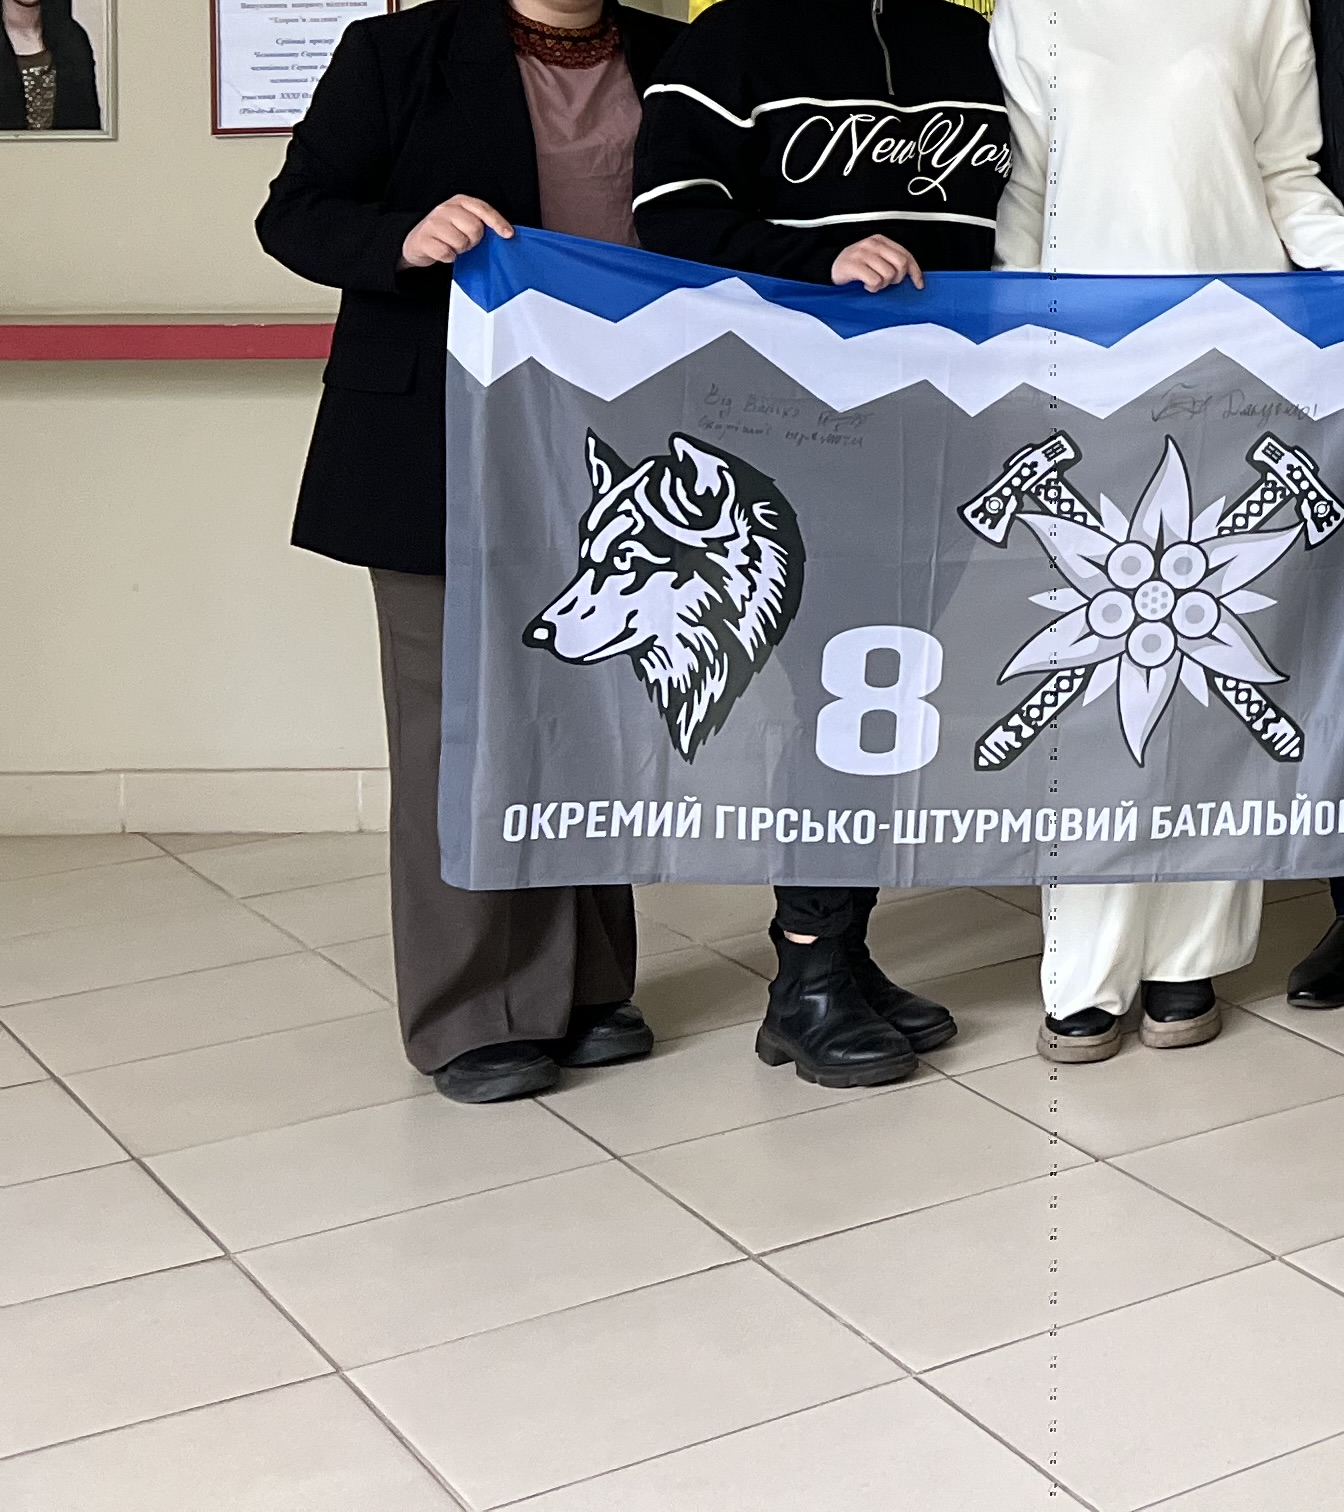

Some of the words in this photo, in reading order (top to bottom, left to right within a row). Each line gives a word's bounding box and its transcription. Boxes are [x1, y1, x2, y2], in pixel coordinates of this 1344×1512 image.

[781, 113, 916, 184] New
[815, 624, 943, 777] 8
[502, 795, 703, 845] ОКРЕМИЙ
[715, 803, 1137, 847] ГІРСЬКО-ШТУРМОВИЙ
